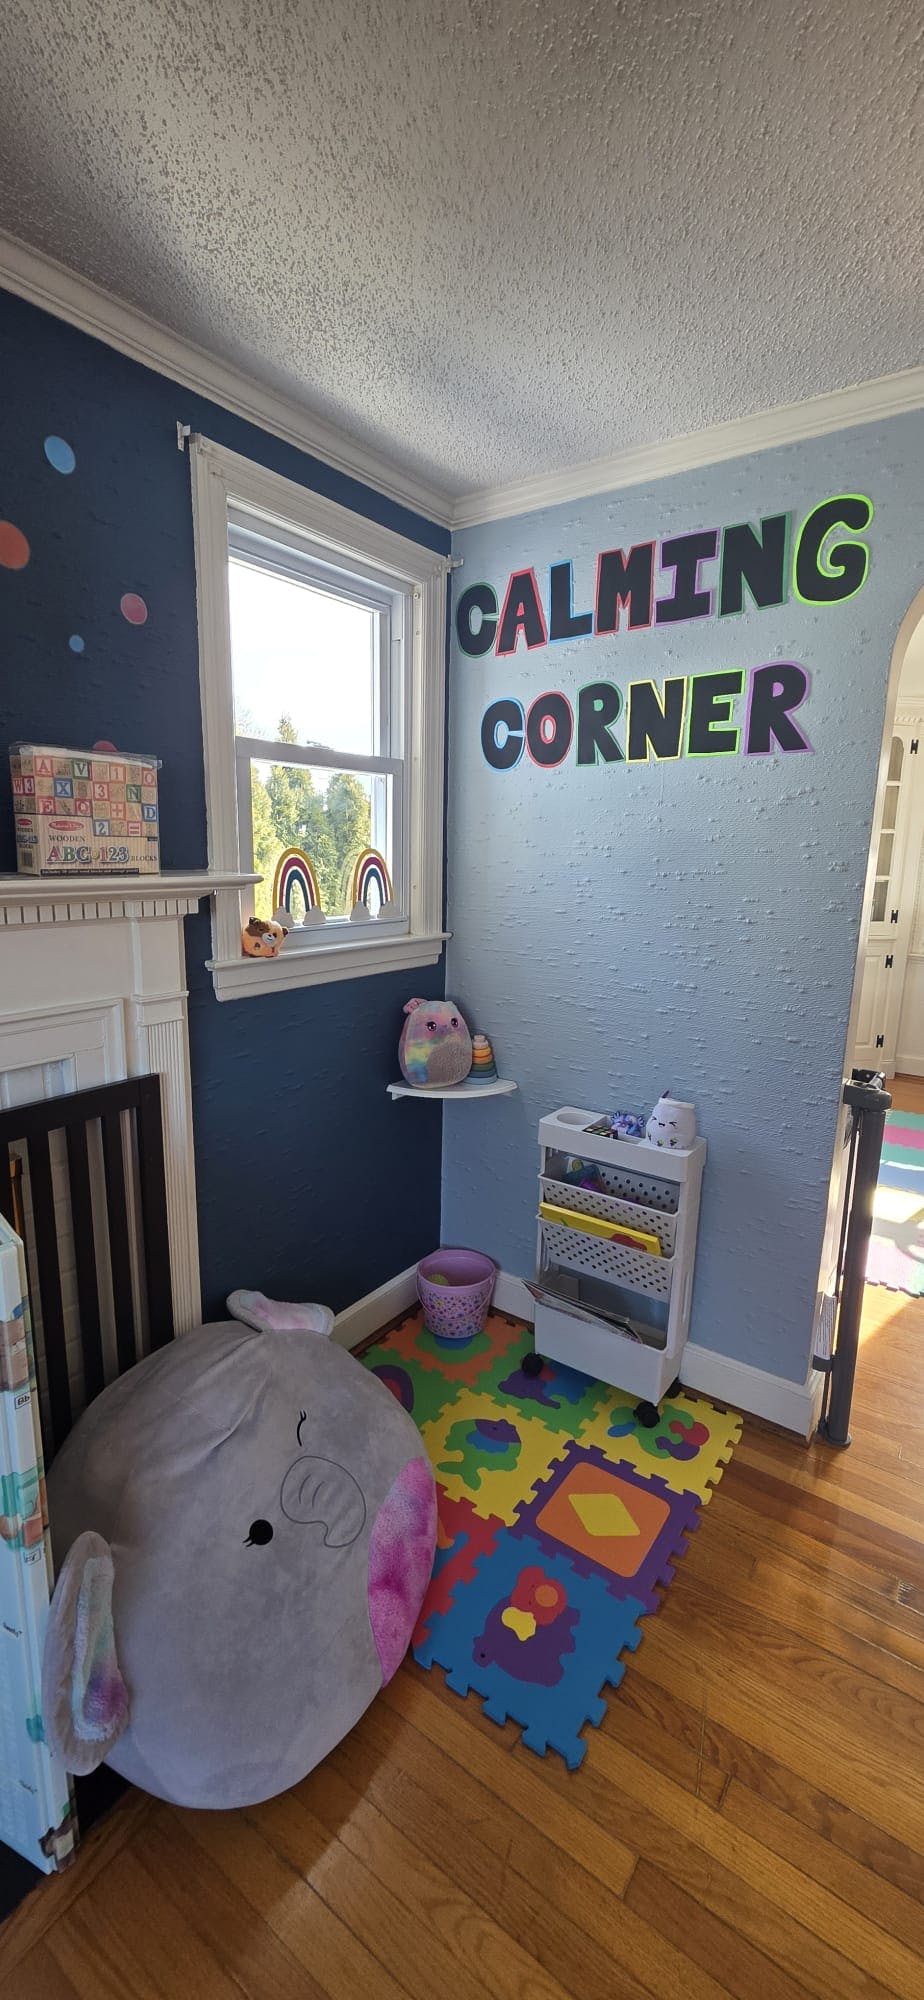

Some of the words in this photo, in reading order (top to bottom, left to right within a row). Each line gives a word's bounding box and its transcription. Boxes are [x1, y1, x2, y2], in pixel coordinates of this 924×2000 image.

[456, 494, 874, 658] CALMING
[480, 661, 814, 772] CORNER
[57, 781, 70, 796] X
